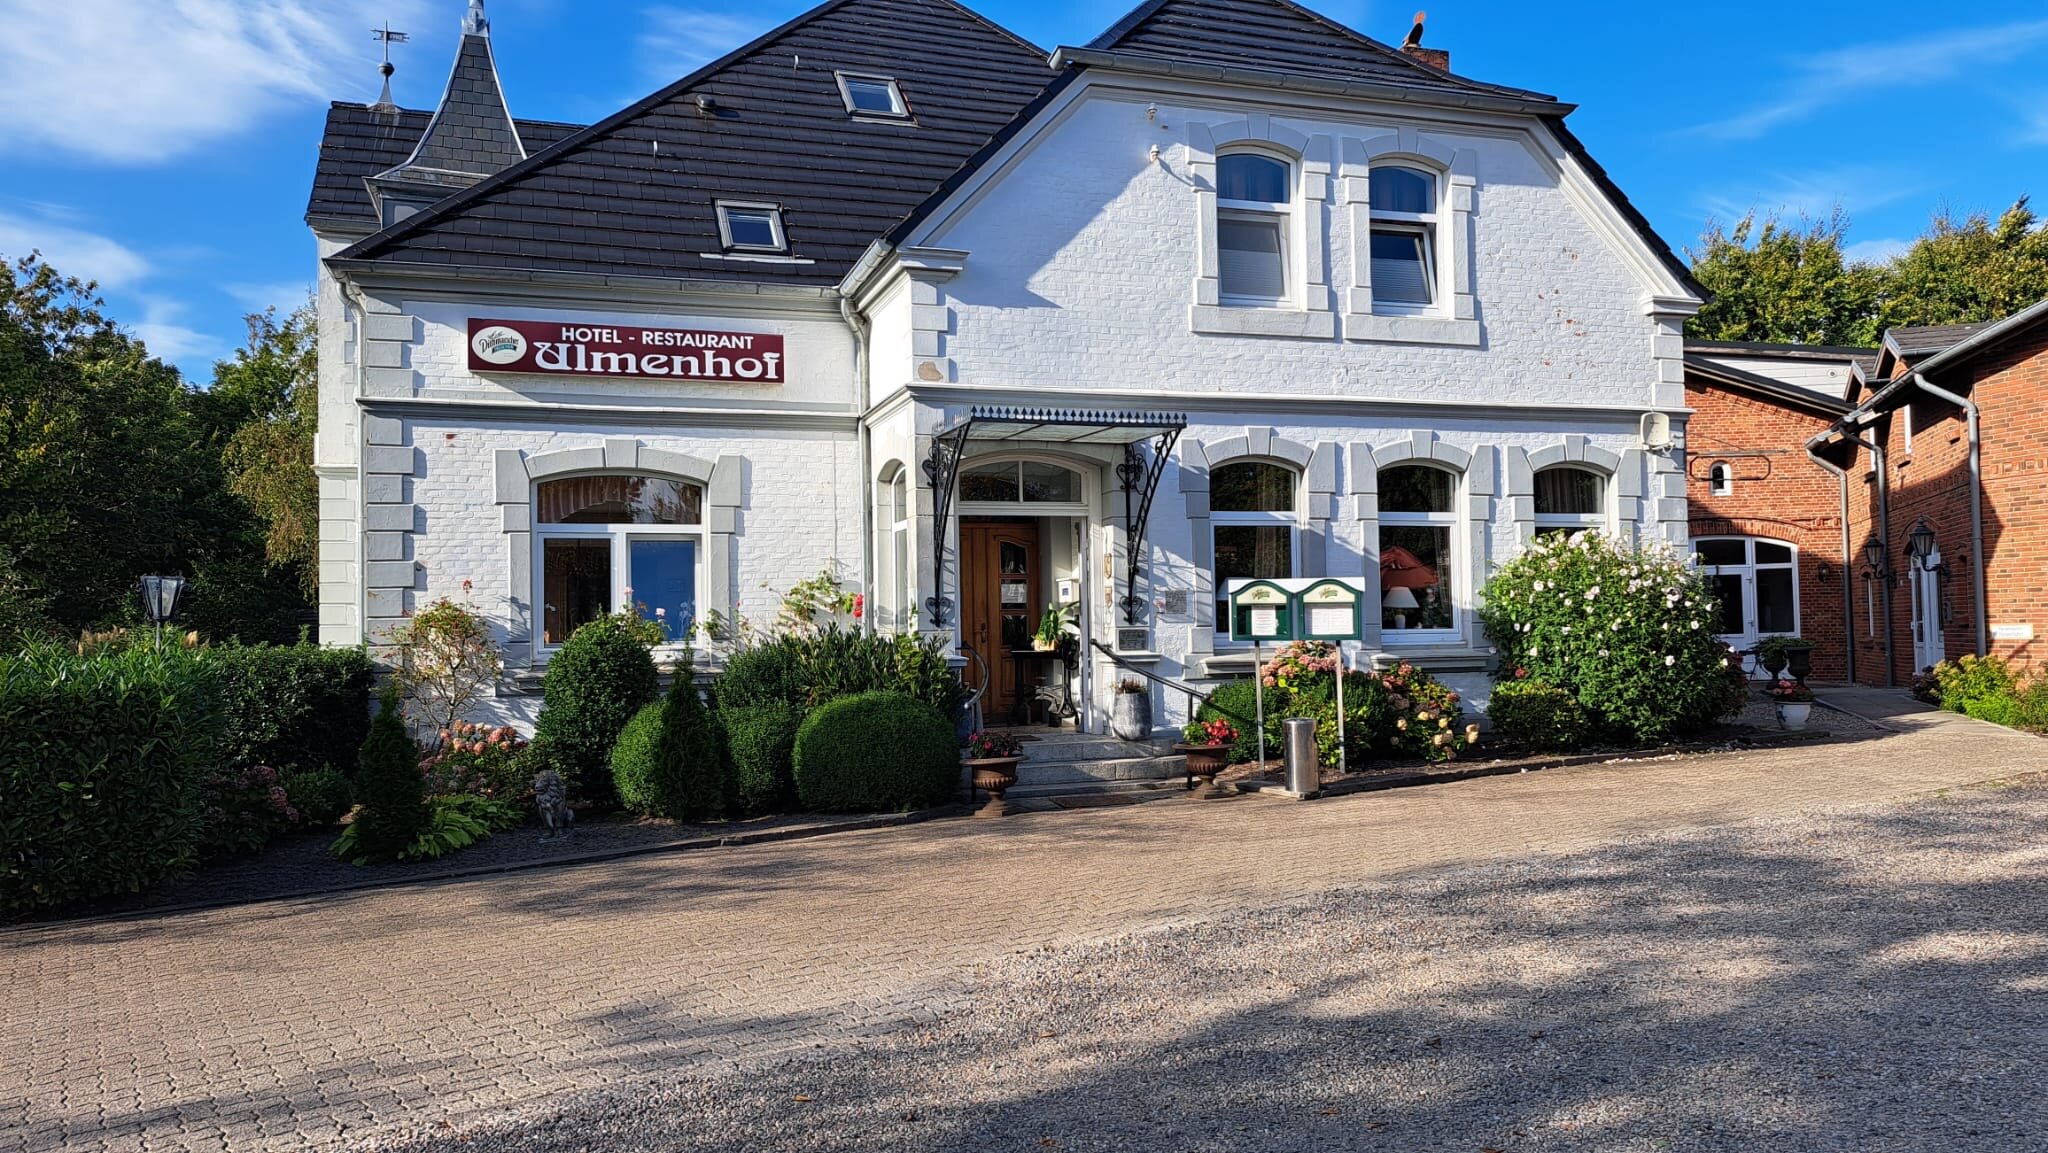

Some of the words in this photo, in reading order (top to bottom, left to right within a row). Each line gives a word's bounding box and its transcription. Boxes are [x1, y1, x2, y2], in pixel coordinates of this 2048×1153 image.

[562, 327, 621, 344] HOTEL
[642, 331, 754, 350] RESTAURANT
[533, 341, 780, 379] Ulmenhof
